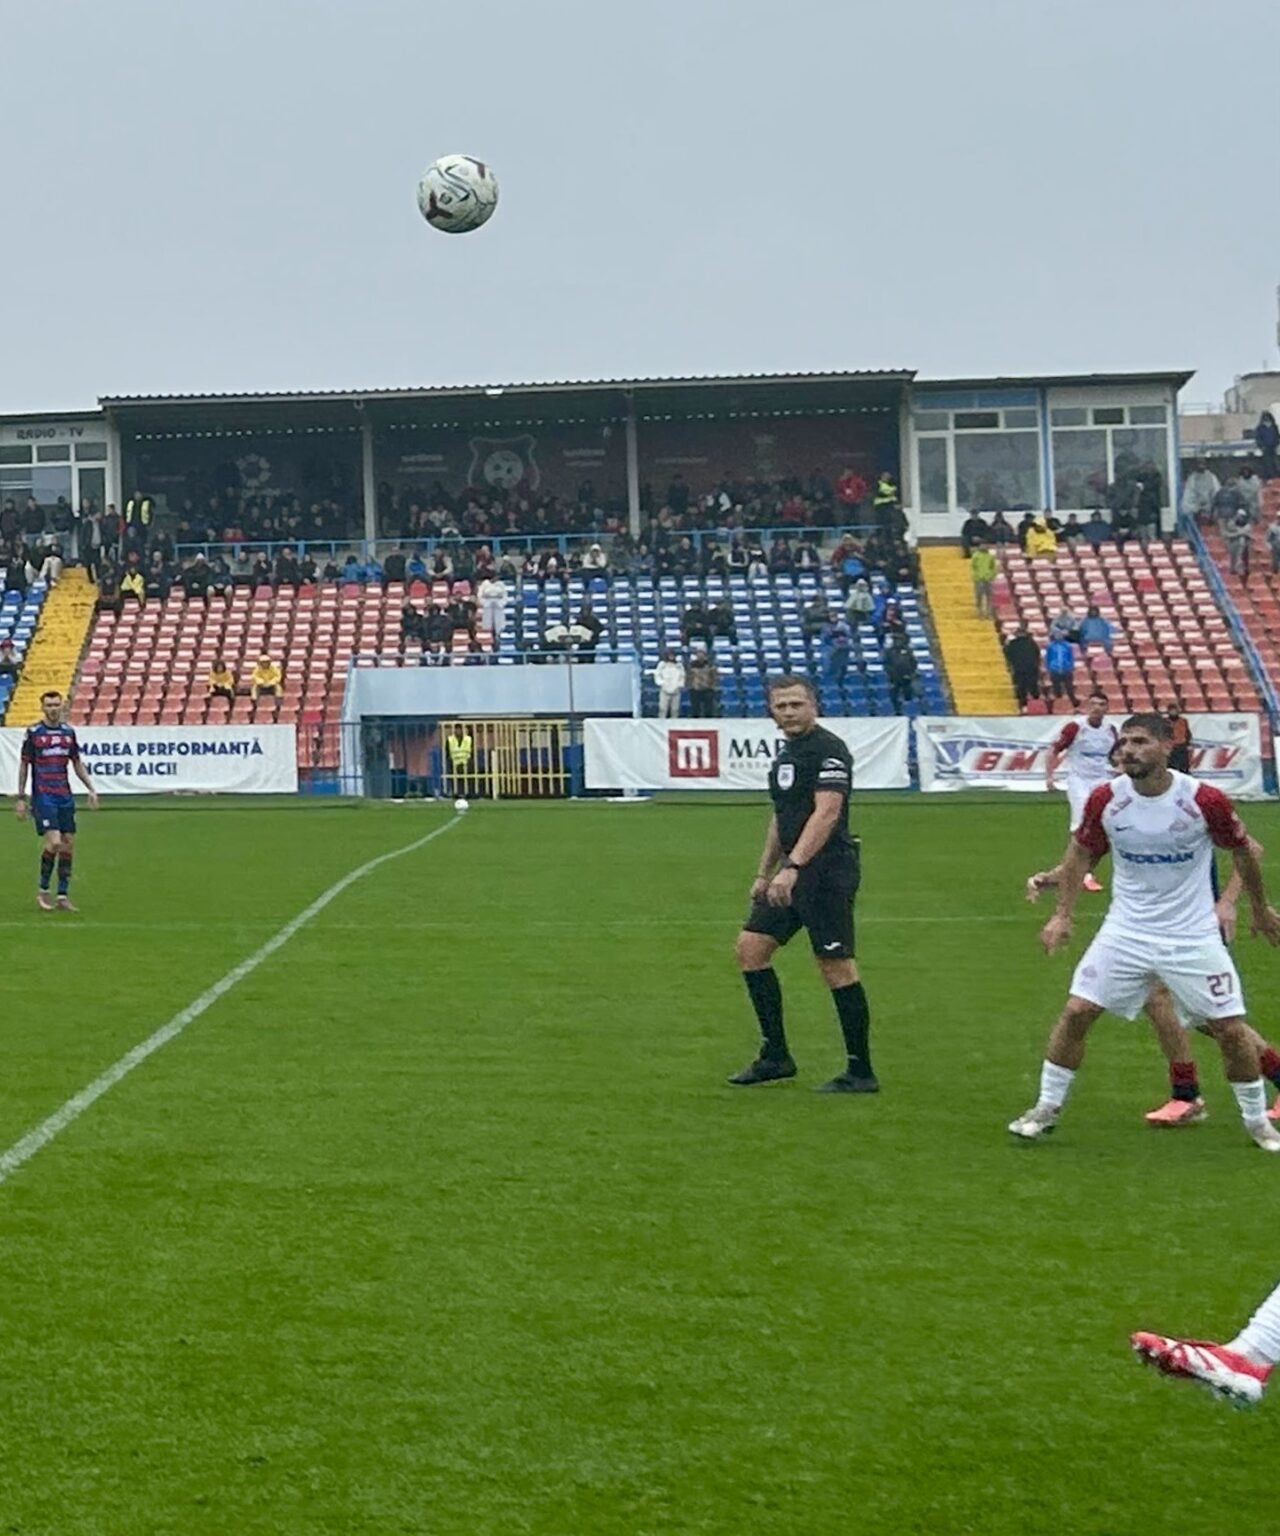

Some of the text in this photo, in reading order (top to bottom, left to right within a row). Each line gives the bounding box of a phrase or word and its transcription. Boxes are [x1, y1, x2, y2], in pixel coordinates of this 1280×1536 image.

[16, 428, 56, 440] RADIO
[69, 427, 84, 438] TV
[1207, 973, 1235, 997] 27
